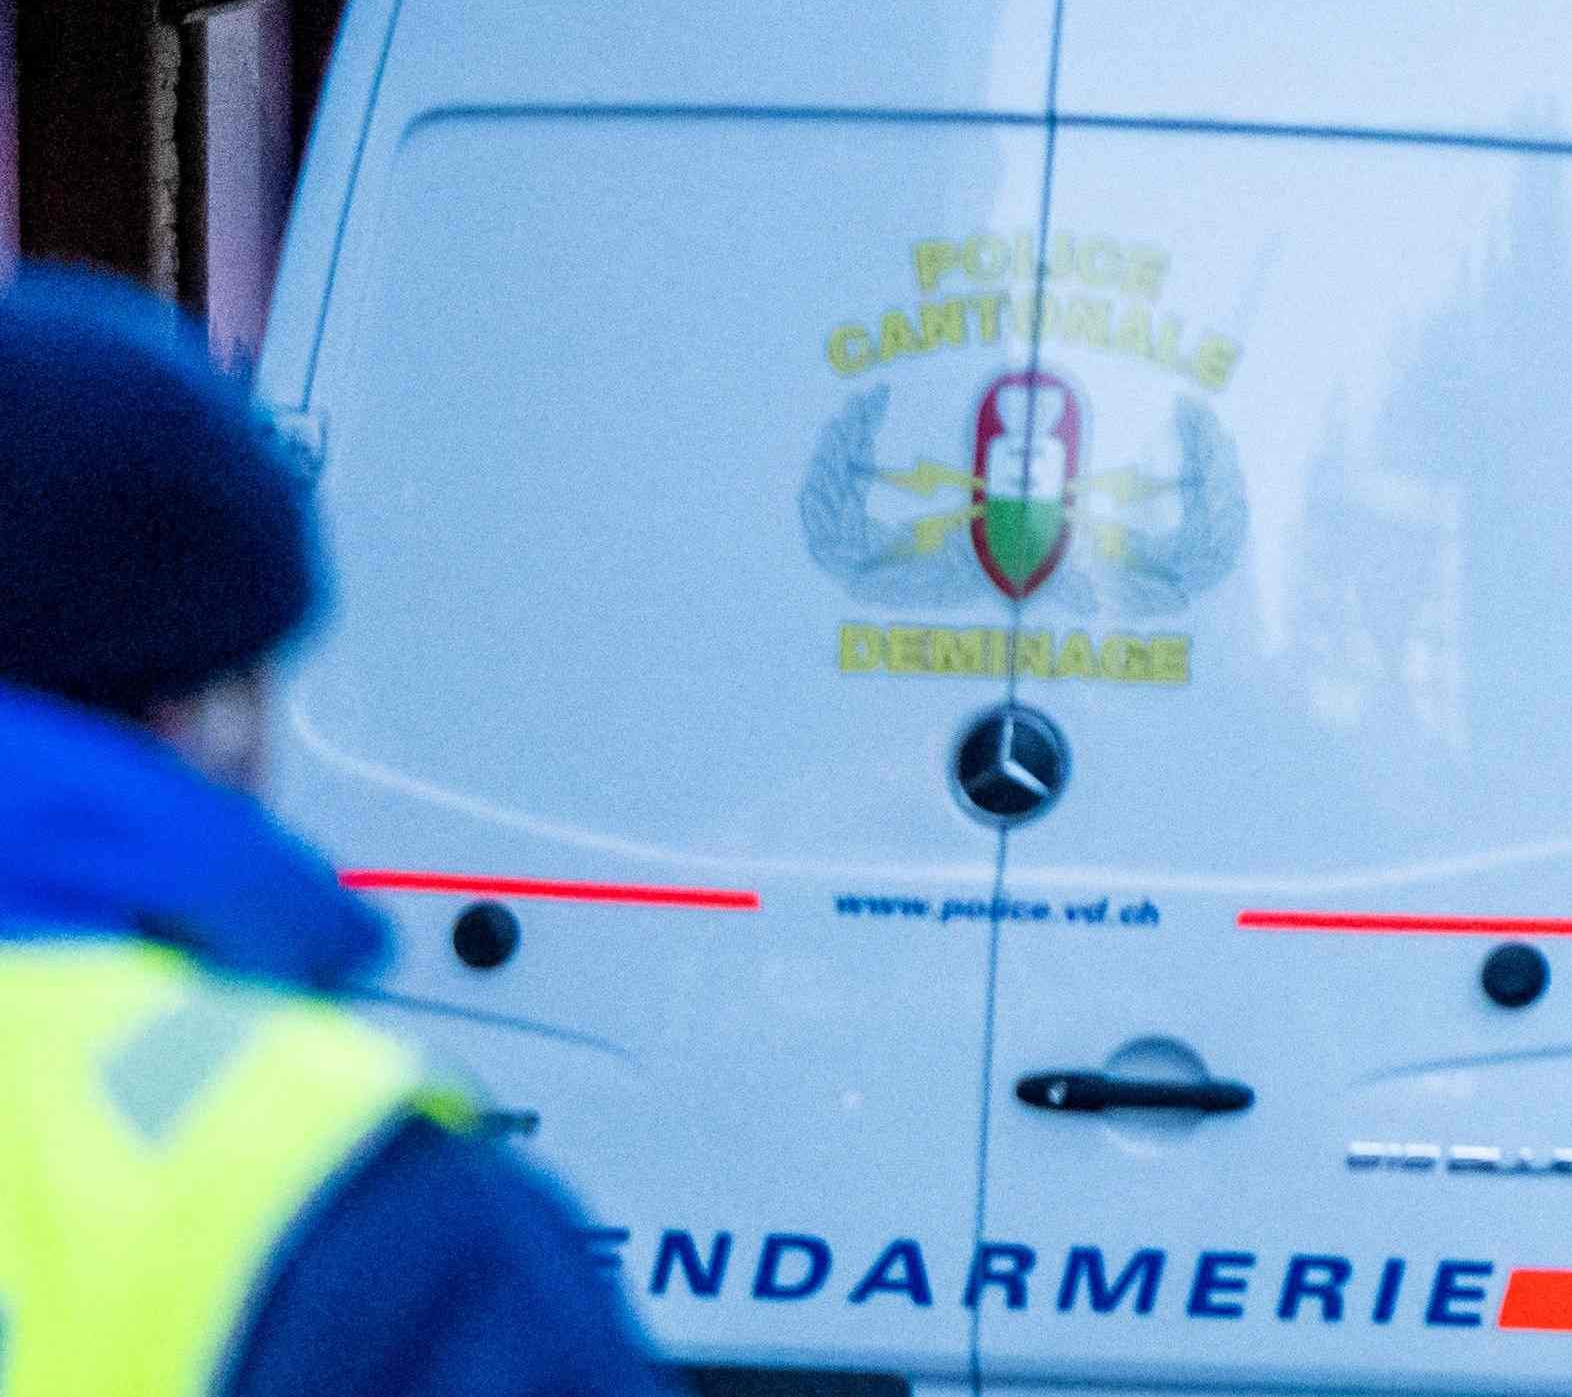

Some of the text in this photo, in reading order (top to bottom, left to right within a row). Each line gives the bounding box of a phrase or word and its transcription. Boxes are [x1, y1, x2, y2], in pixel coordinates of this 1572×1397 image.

[912, 233, 1168, 299] POLICE
[826, 291, 1243, 390] CANTONALE
[838, 621, 1192, 683] DEMINAGE
[833, 891, 1160, 926] www.police.vd.ch
